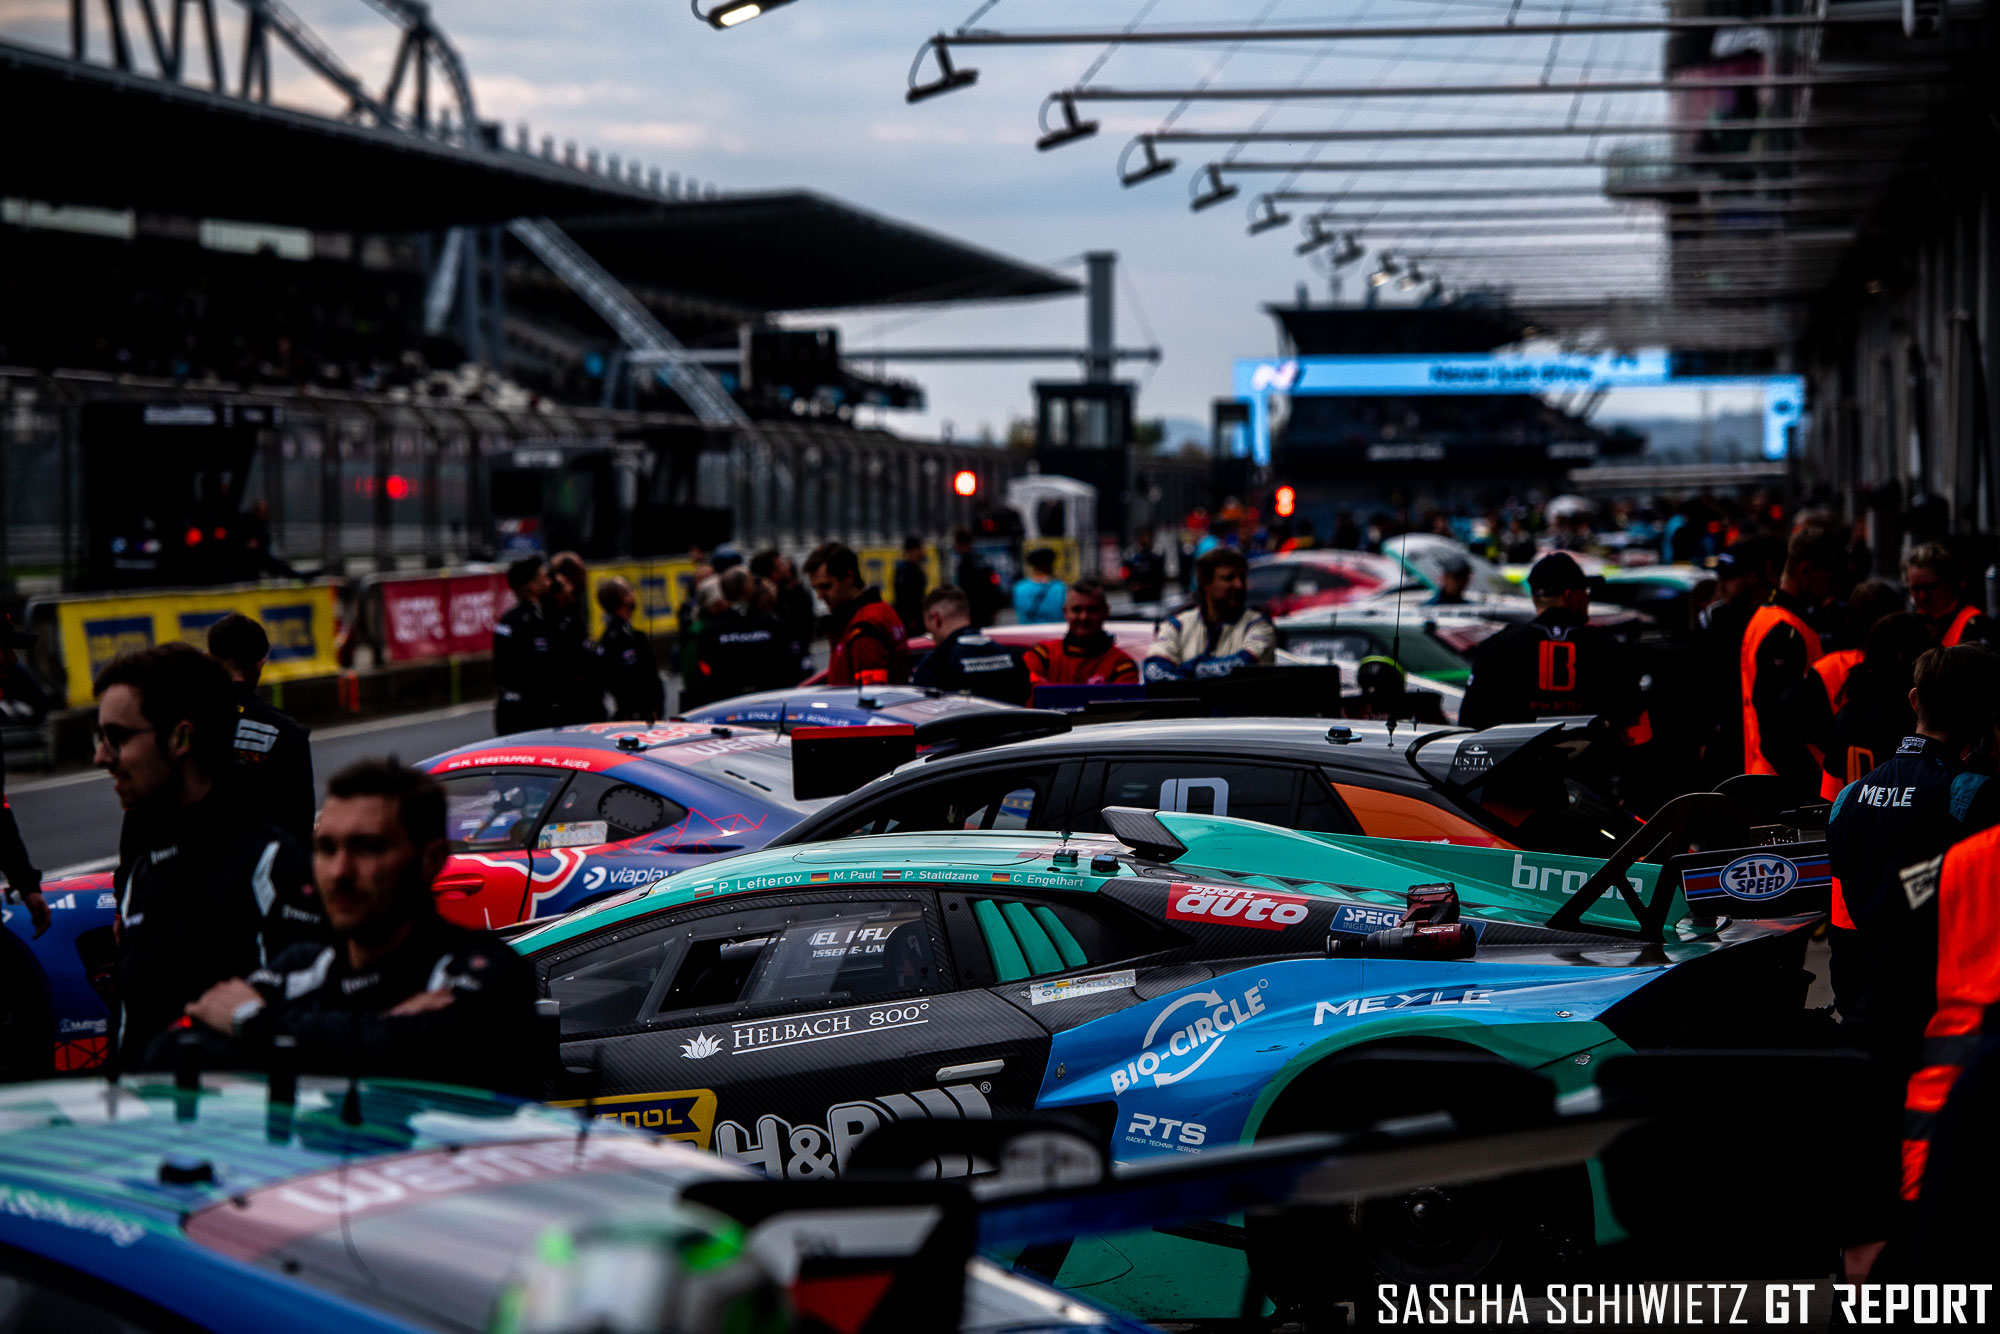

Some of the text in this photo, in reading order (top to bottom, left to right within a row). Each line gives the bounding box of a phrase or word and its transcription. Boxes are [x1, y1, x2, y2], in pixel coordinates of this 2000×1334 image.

[474, 755, 536, 766] VERSTAPPEN
[562, 758, 591, 770] AUER
[1454, 756, 1494, 767] ESTIA
[1857, 784, 1917, 808] MEYLE
[718, 869, 1084, 894] P. Lefterov M. Paul P. Stalidzane C. Engelhart
[1511, 853, 1645, 901] bro
[1735, 875, 1787, 894] SPEED
[1186, 885, 1260, 899] sport
[1175, 893, 1310, 925] auto
[1313, 989, 1495, 1027] MEYLE
[733, 1003, 930, 1049] HELBACH 800°
[1128, 1112, 1208, 1146] RTS
[1148, 1139, 1175, 1150] TECHNIK
